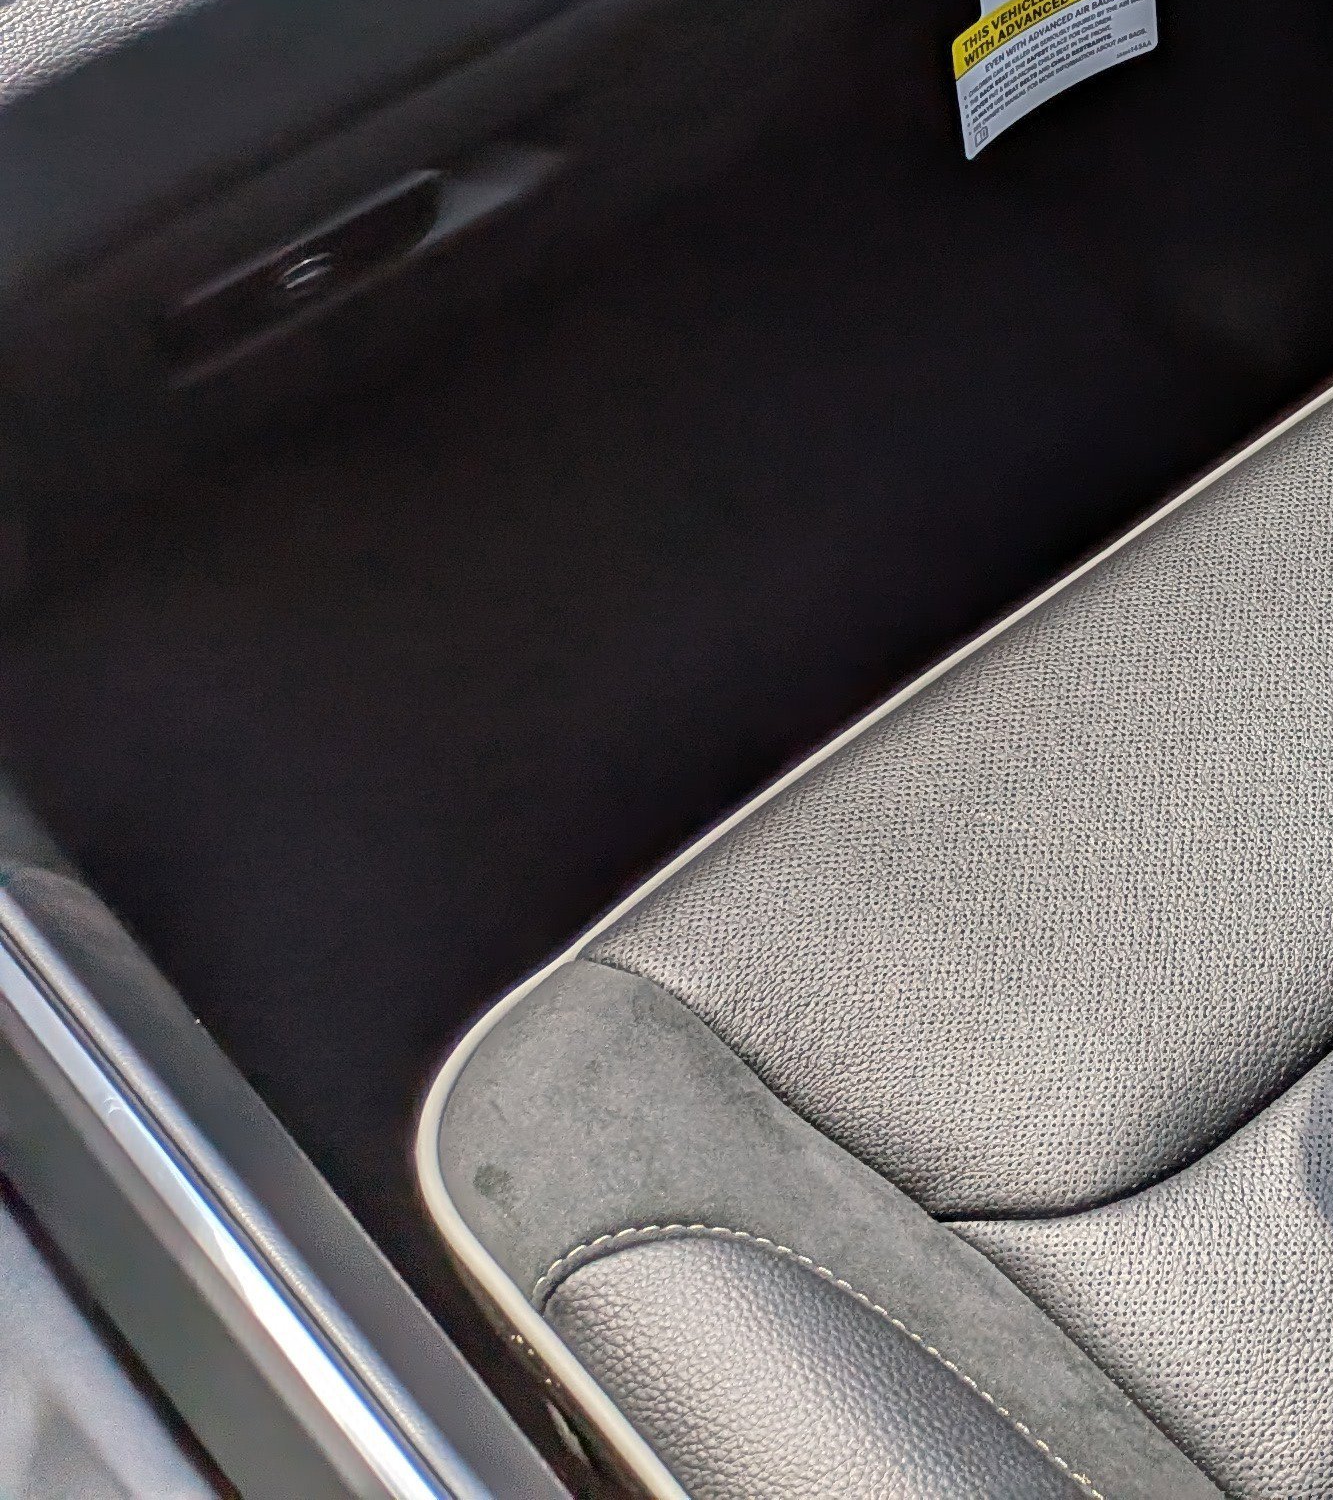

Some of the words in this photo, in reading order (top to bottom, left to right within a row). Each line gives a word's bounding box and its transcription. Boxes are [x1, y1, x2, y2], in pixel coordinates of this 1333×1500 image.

[962, 25, 989, 51] THIS
[964, 36, 994, 65] WITH
[985, 52, 1004, 72] EVEN
[1006, 38, 1026, 56] WITH
[1028, 13, 1073, 43] ADVANCED
[1075, 5, 1089, 18] AIR
